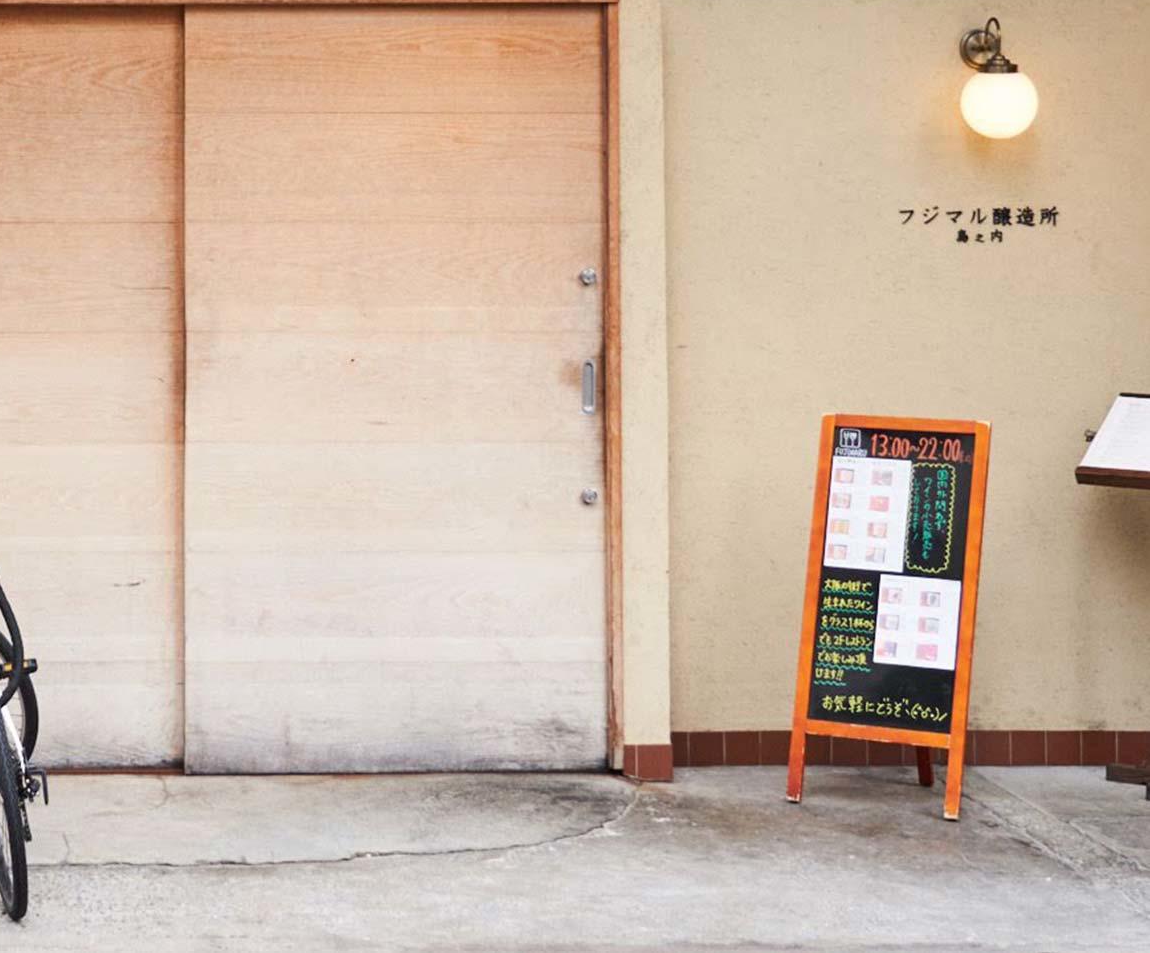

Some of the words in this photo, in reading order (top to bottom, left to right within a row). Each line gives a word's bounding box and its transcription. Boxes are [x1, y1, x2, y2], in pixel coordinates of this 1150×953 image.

[898, 206, 1059, 227] フジマル醸造所
[956, 229, 1003, 243] 島之内
